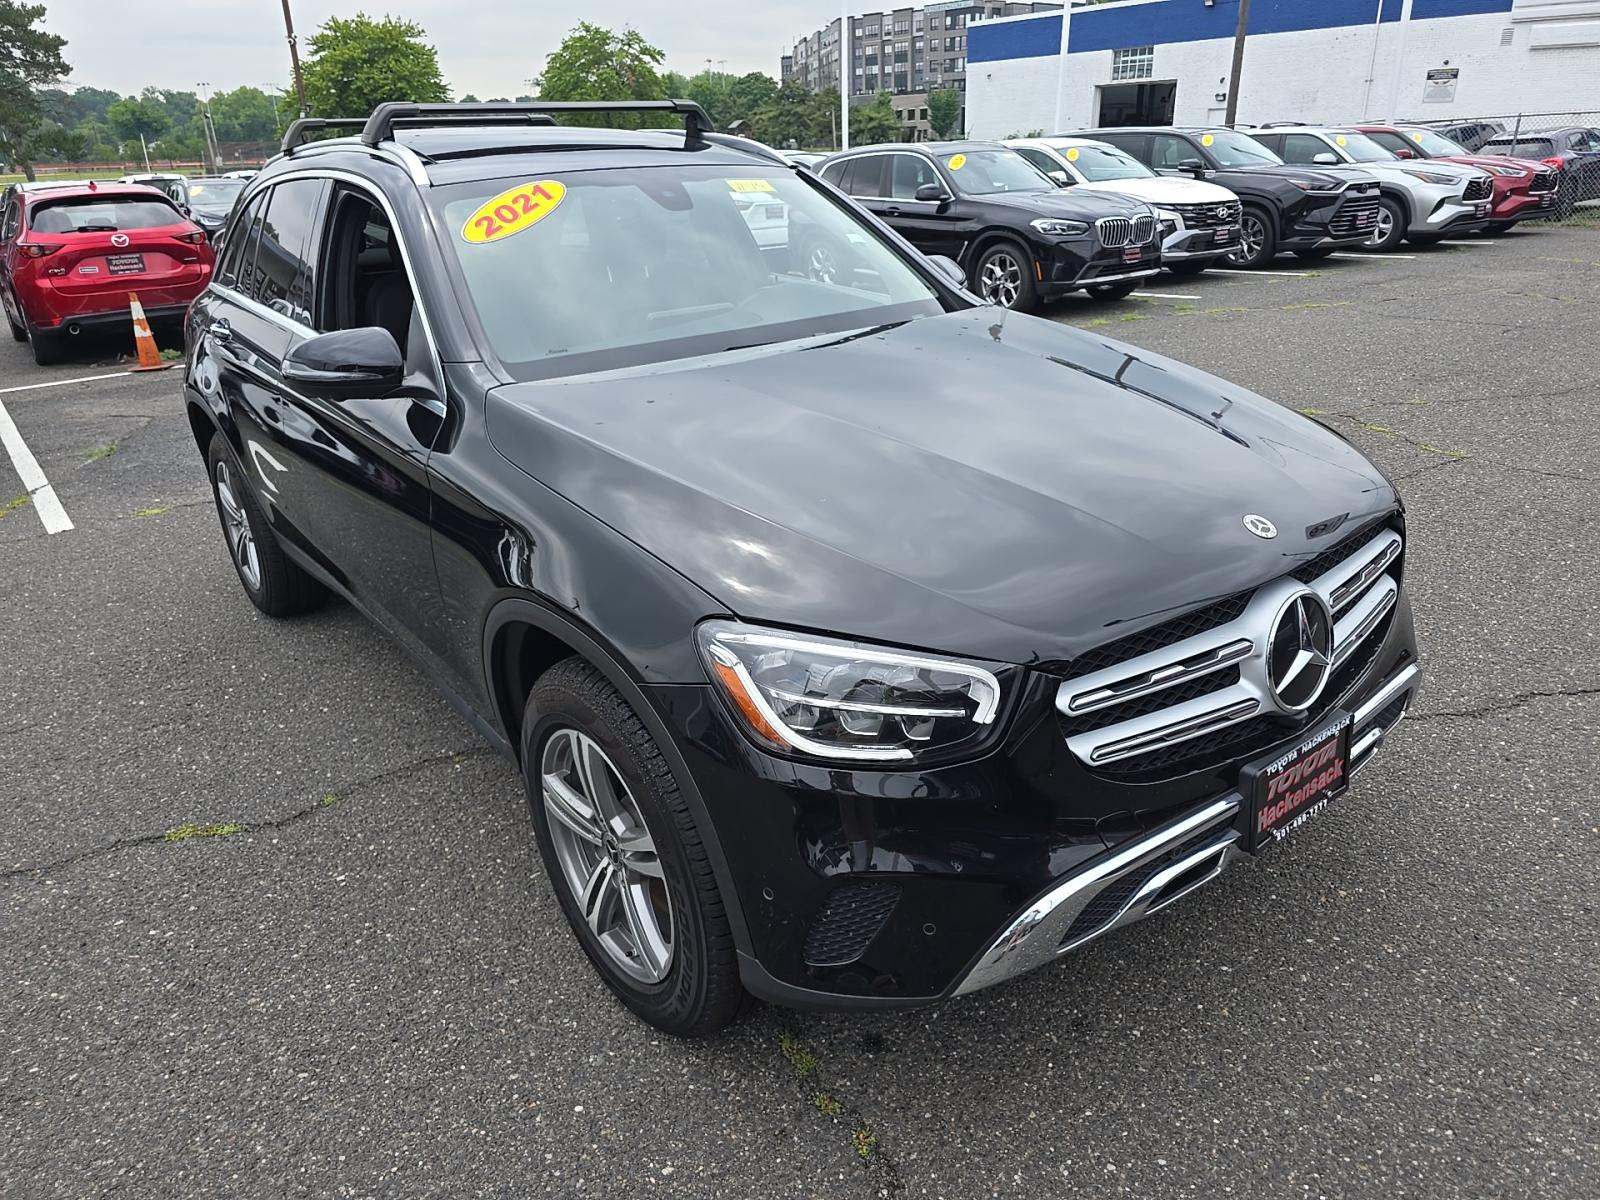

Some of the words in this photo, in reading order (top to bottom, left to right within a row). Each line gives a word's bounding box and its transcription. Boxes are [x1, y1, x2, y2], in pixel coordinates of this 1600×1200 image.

[475, 185, 553, 238] 2021
[1266, 750, 1298, 777] TOYOTA
[1301, 716, 1351, 755] HACKENSACK
[1267, 739, 1339, 801] TOYOTA
[1257, 759, 1345, 833] Hackensack
